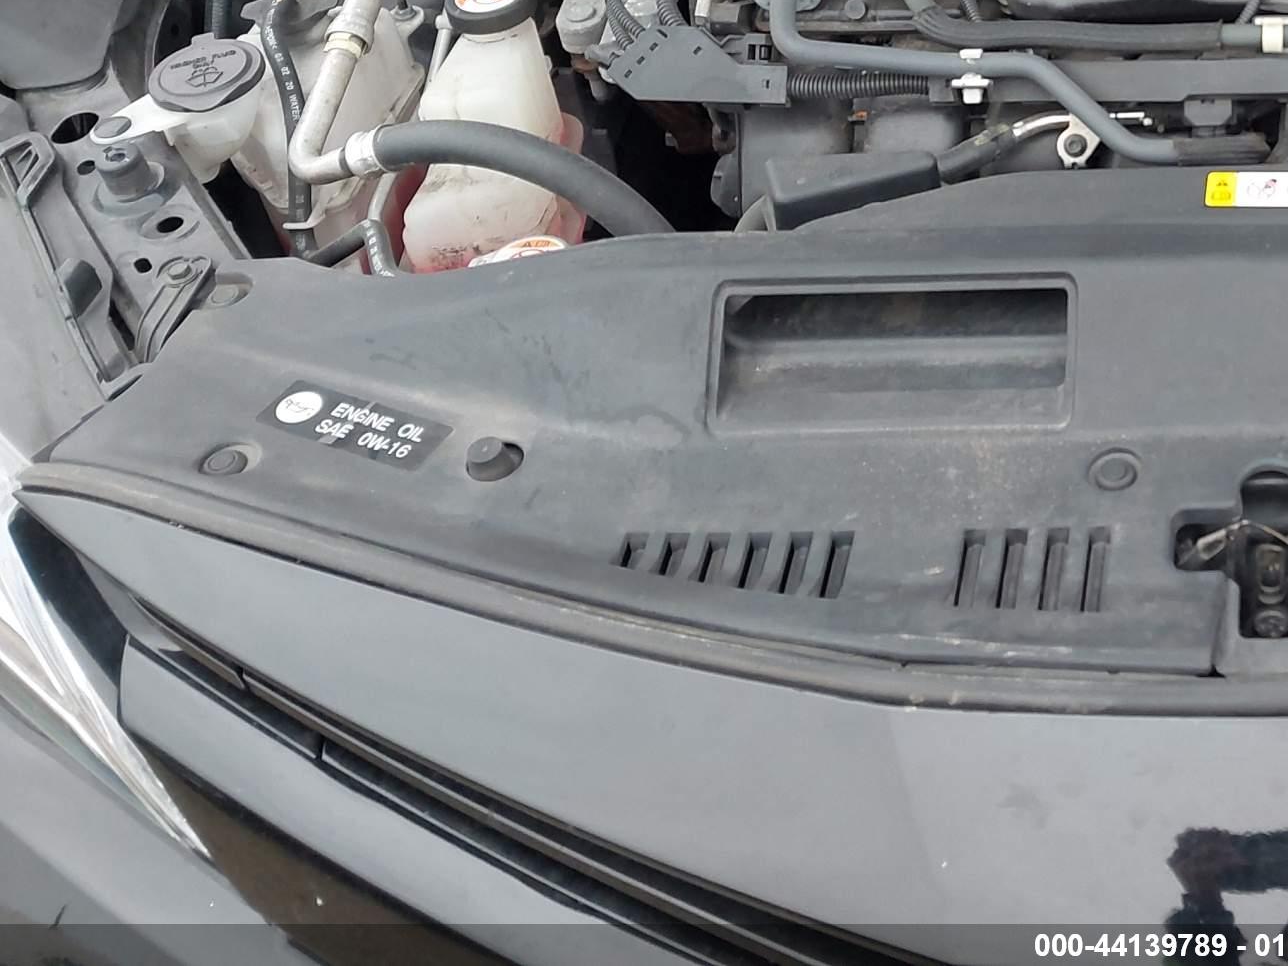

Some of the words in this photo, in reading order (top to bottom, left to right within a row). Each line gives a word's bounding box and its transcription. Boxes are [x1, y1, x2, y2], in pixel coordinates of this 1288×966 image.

[315, 419, 354, 439] SAE
[357, 432, 412, 458] 0W-16
[331, 402, 395, 432] ENGINE
[397, 423, 425, 443] OIL
